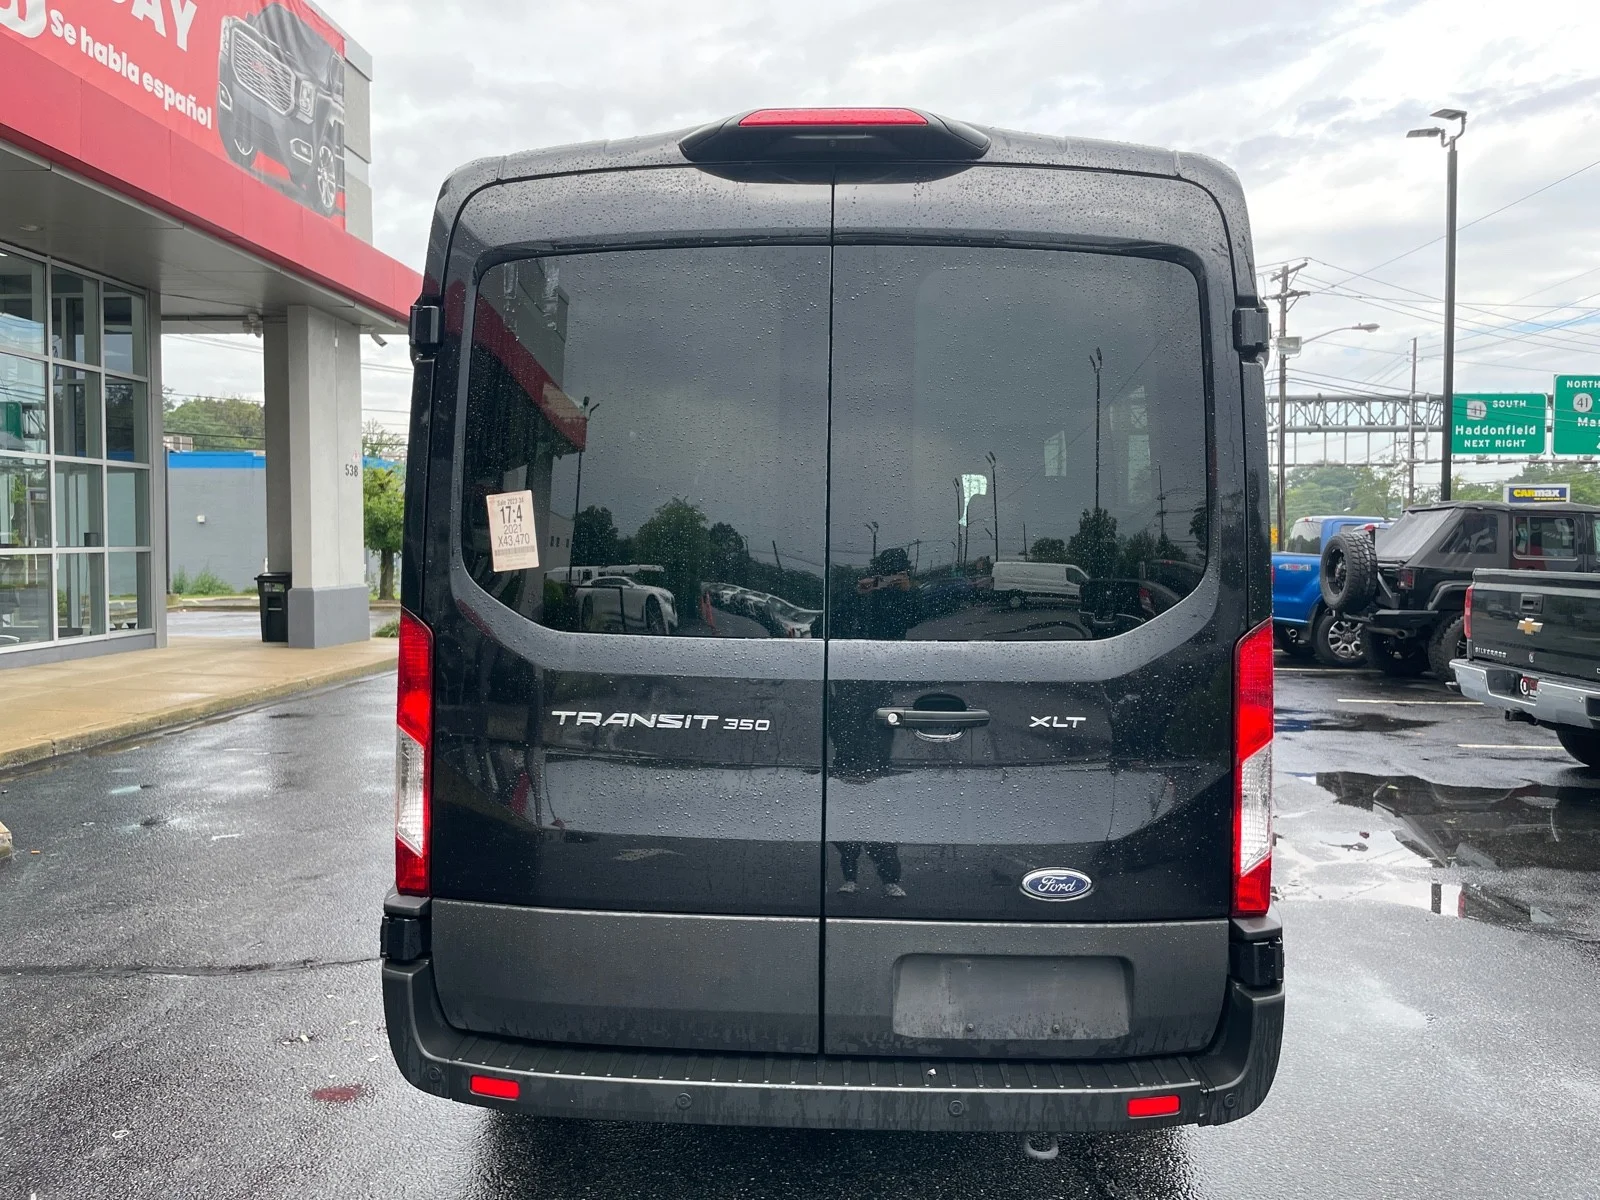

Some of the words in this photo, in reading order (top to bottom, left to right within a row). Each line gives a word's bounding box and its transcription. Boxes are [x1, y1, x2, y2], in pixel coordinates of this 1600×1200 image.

[50, 9, 77, 46] Se
[80, 26, 140, 86] habla
[142, 71, 212, 130] español
[1566, 380, 1600, 389] NORTH
[1492, 400, 1527, 408] SOUTH
[1577, 397, 1588, 407] 41
[1455, 425, 1537, 436] Haddonfield
[1464, 439, 1491, 448] NEXT
[1495, 439, 1527, 448] RIGHT
[345, 463, 359, 477] 538
[504, 524, 522, 534] 2021
[551, 710, 719, 730] TRANSIT
[723, 717, 770, 731] 350
[1028, 715, 1087, 729] XLT
[1036, 875, 1078, 893] Ford
